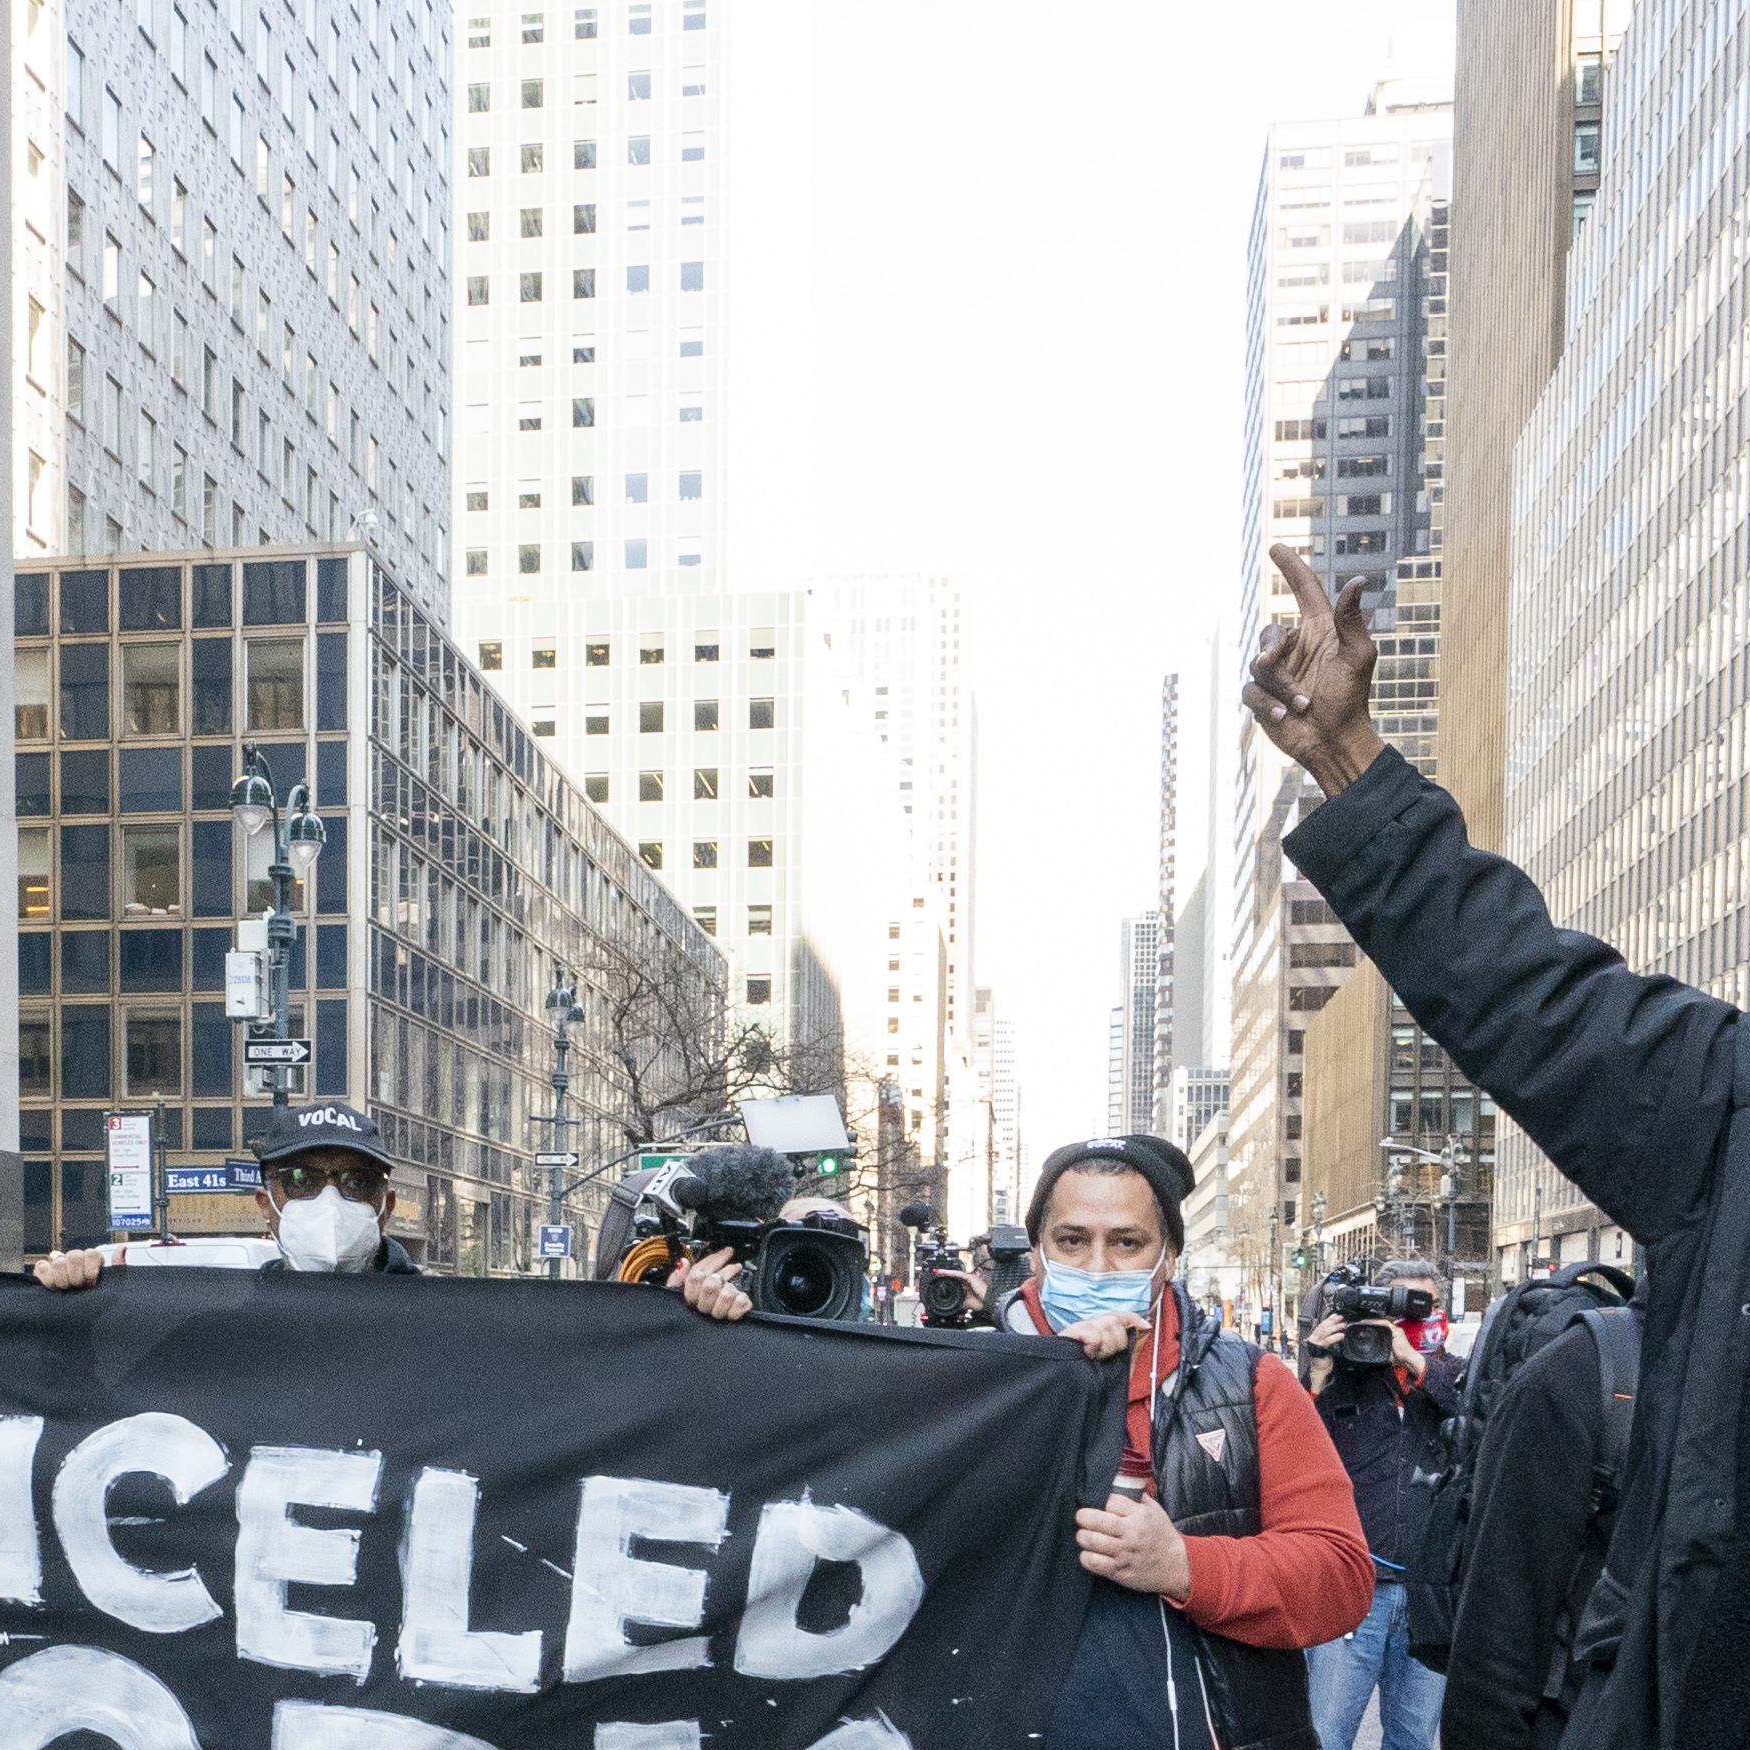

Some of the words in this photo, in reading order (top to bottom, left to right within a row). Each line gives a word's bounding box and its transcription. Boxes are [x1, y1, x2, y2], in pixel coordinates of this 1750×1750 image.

[253, 1046, 273, 1057] ONE
[281, 1046, 302, 1057] WAY
[298, 1107, 362, 1132] VOCAL
[168, 1174, 199, 1188] East
[202, 1174, 227, 1188] 41s
[234, 1168, 253, 1184] Third
